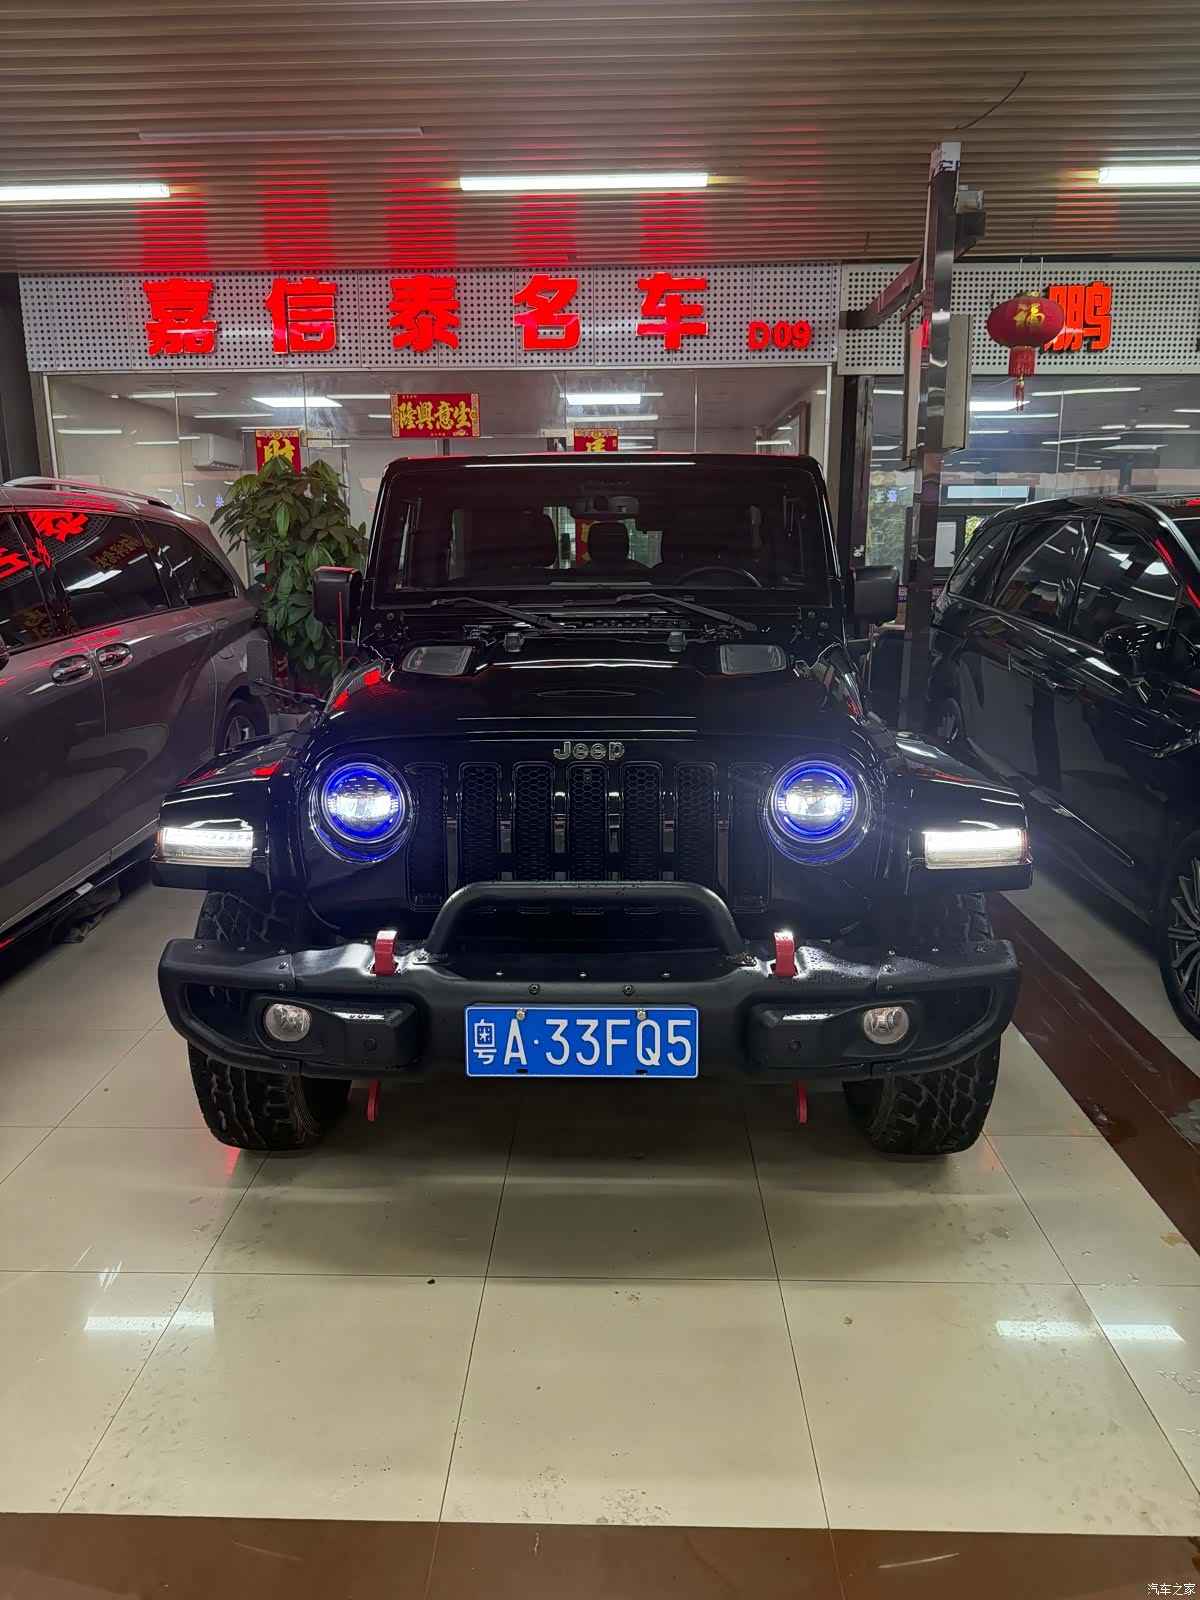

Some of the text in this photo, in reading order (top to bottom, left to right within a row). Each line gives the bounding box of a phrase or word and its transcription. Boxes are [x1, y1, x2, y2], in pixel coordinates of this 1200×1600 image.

[142, 271, 710, 356] 嘉信泰名车
[748, 320, 811, 350] D09
[553, 741, 625, 760] Jeep
